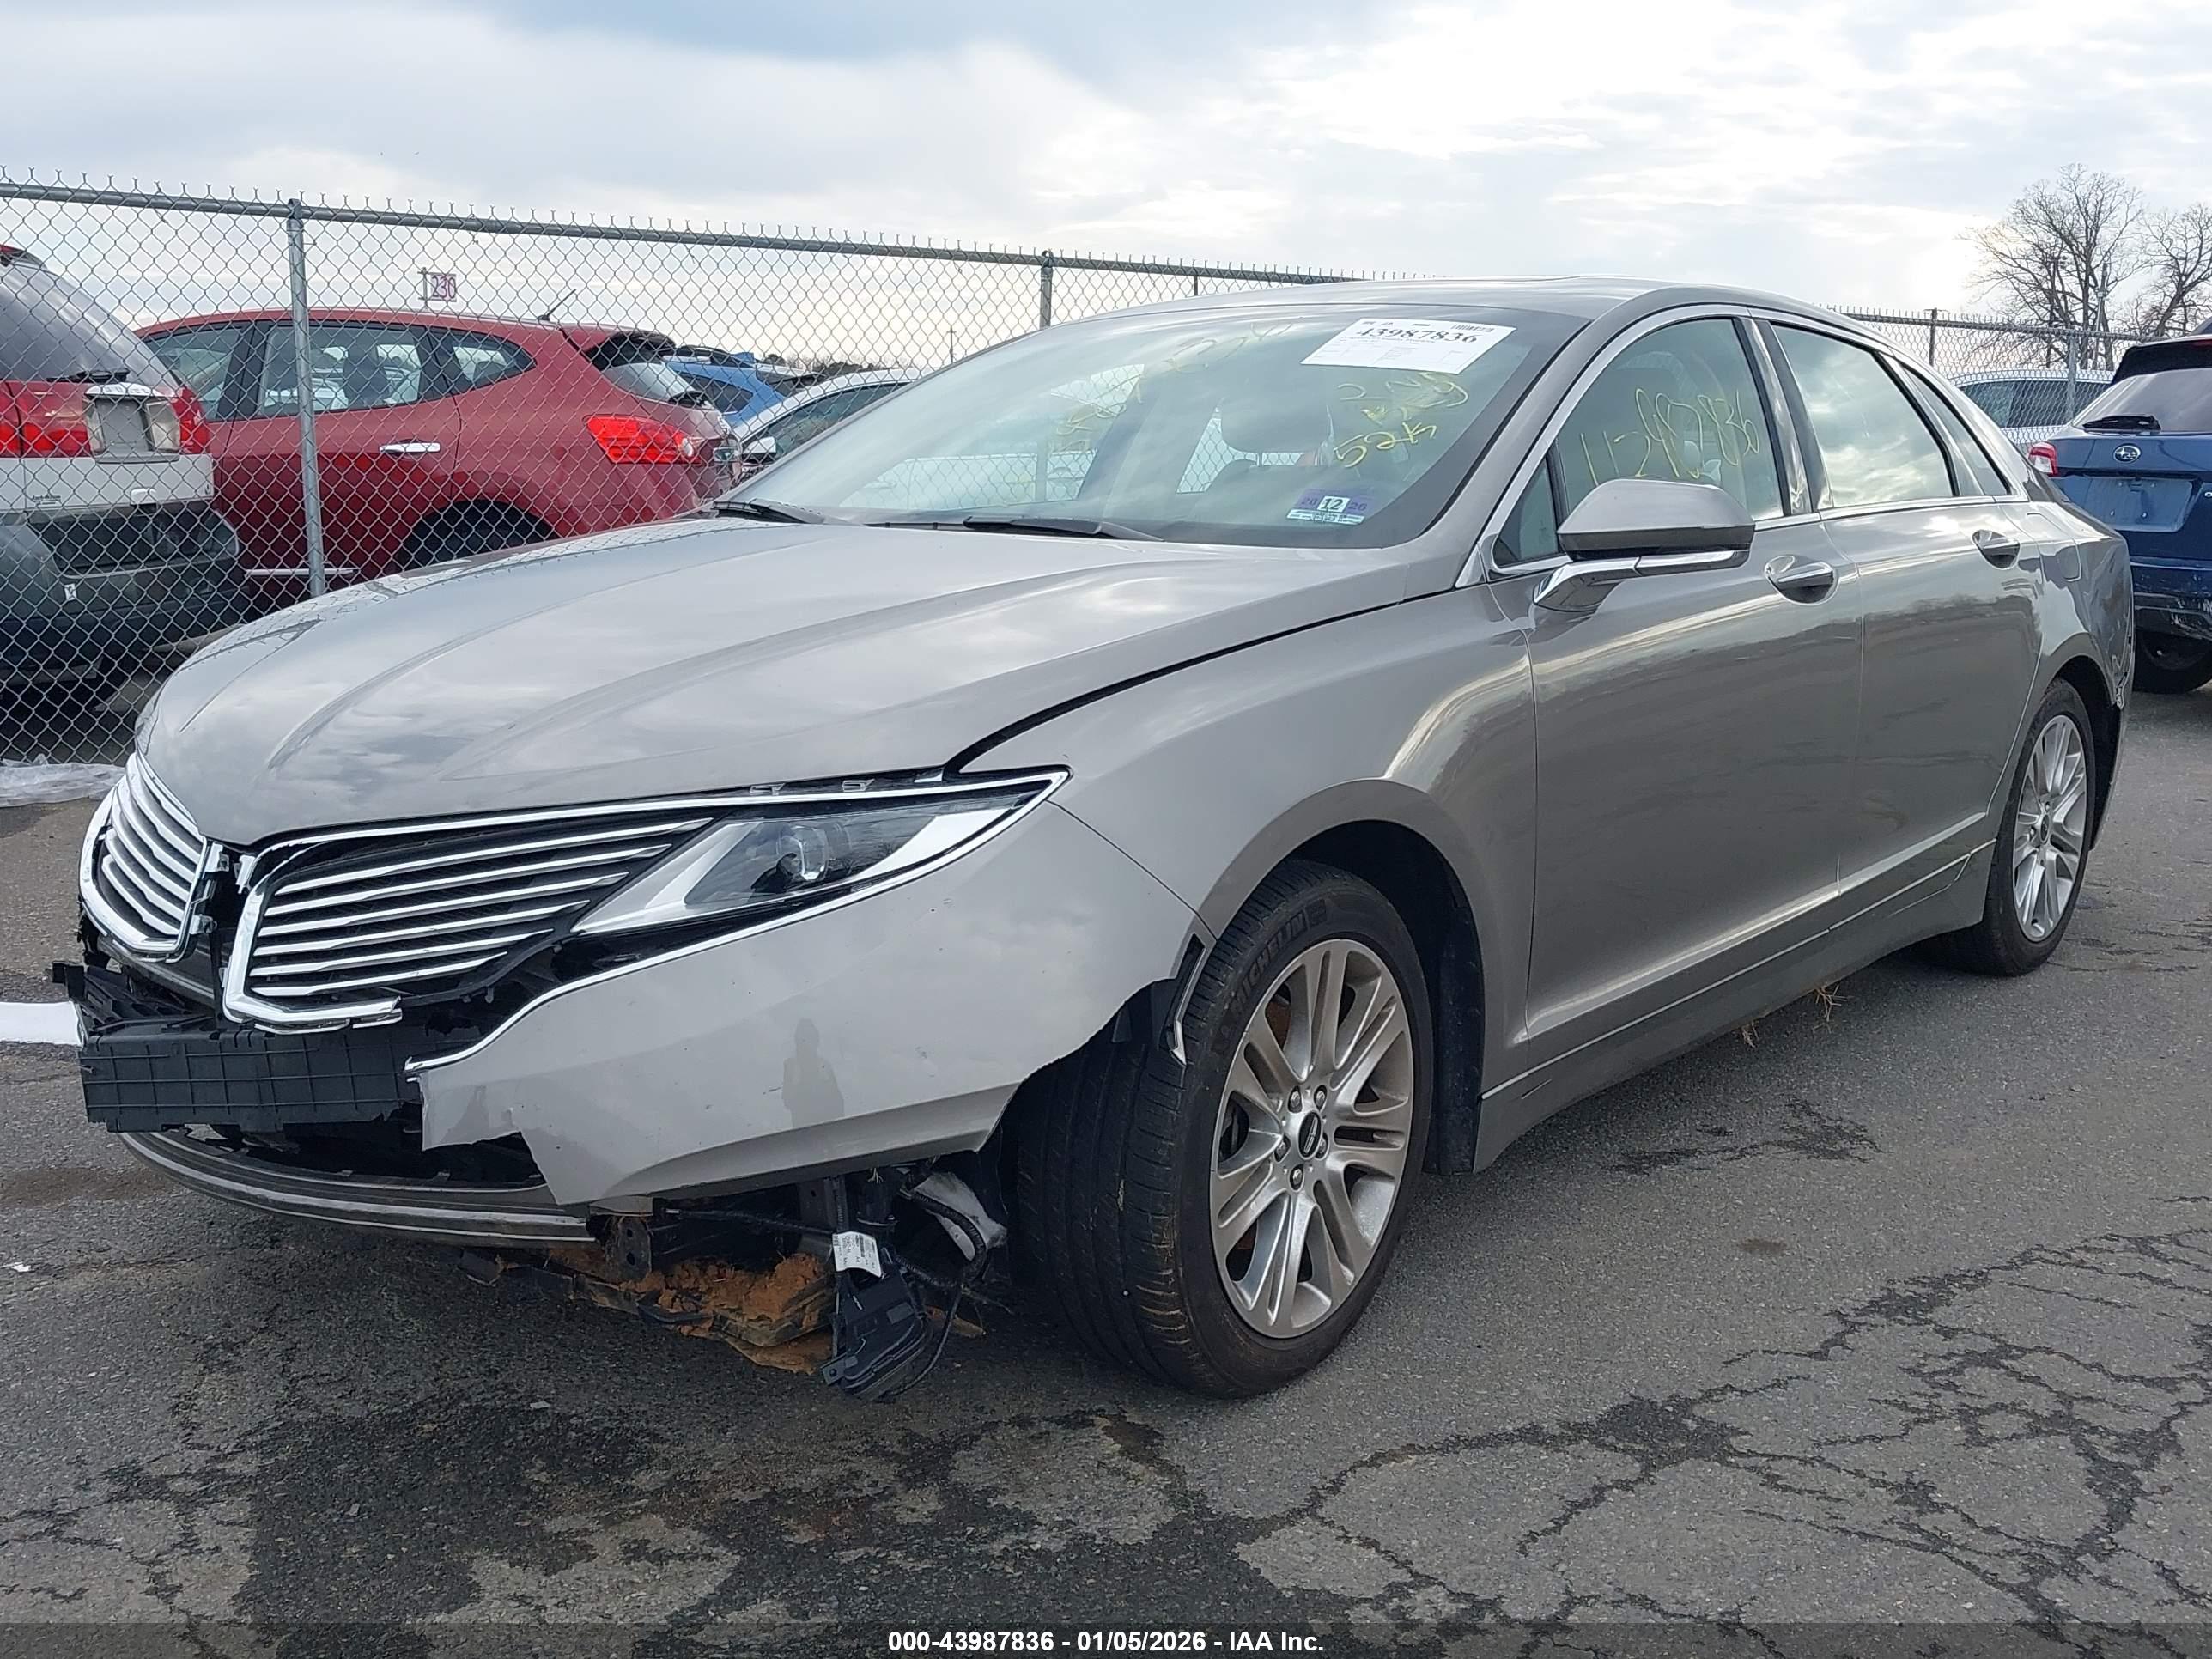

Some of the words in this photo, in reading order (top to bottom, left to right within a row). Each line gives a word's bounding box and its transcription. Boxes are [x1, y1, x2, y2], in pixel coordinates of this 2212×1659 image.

[431, 275, 457, 299] 230
[1357, 327, 1480, 343] 43987836
[1321, 497, 1344, 511] 12
